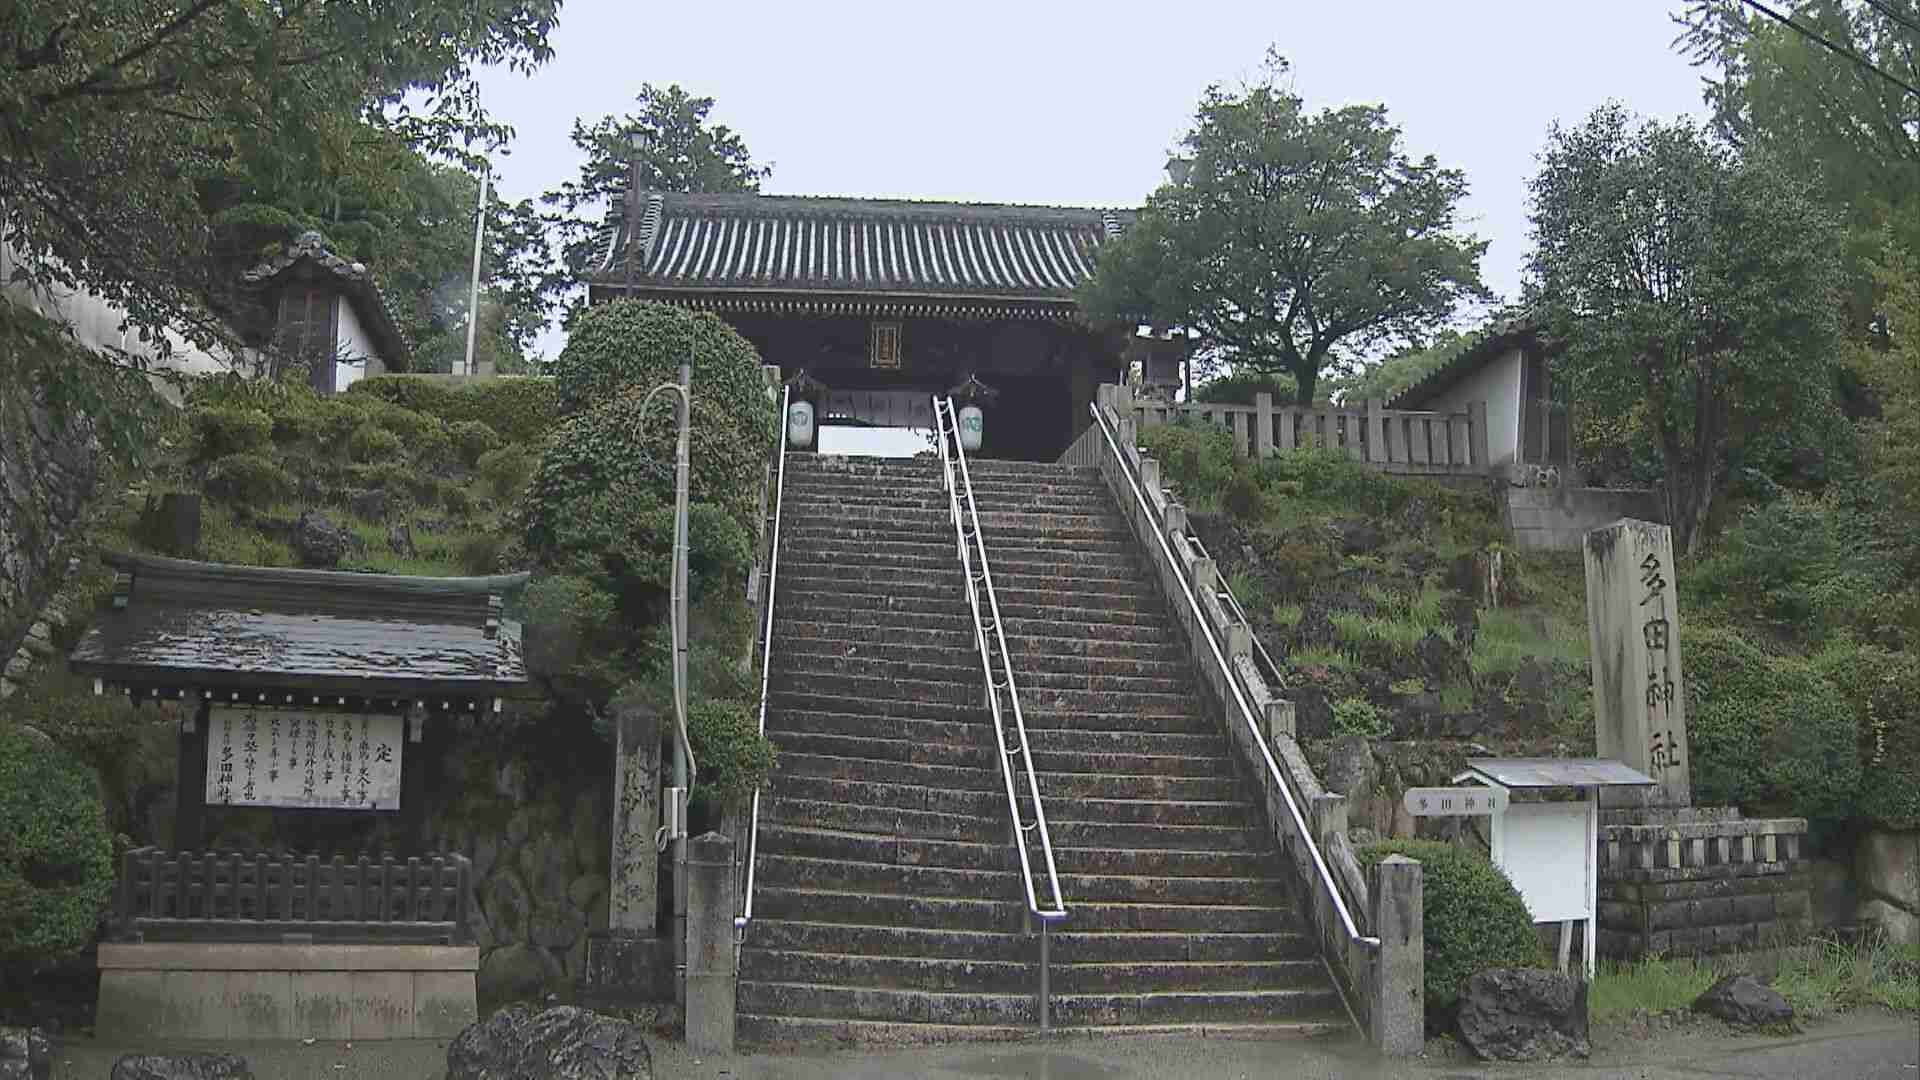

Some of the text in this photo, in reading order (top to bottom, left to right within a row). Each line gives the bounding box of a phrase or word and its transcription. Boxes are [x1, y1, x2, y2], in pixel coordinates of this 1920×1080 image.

[1639, 552, 1681, 777] 多田神社
[375, 743, 393, 763] 定
